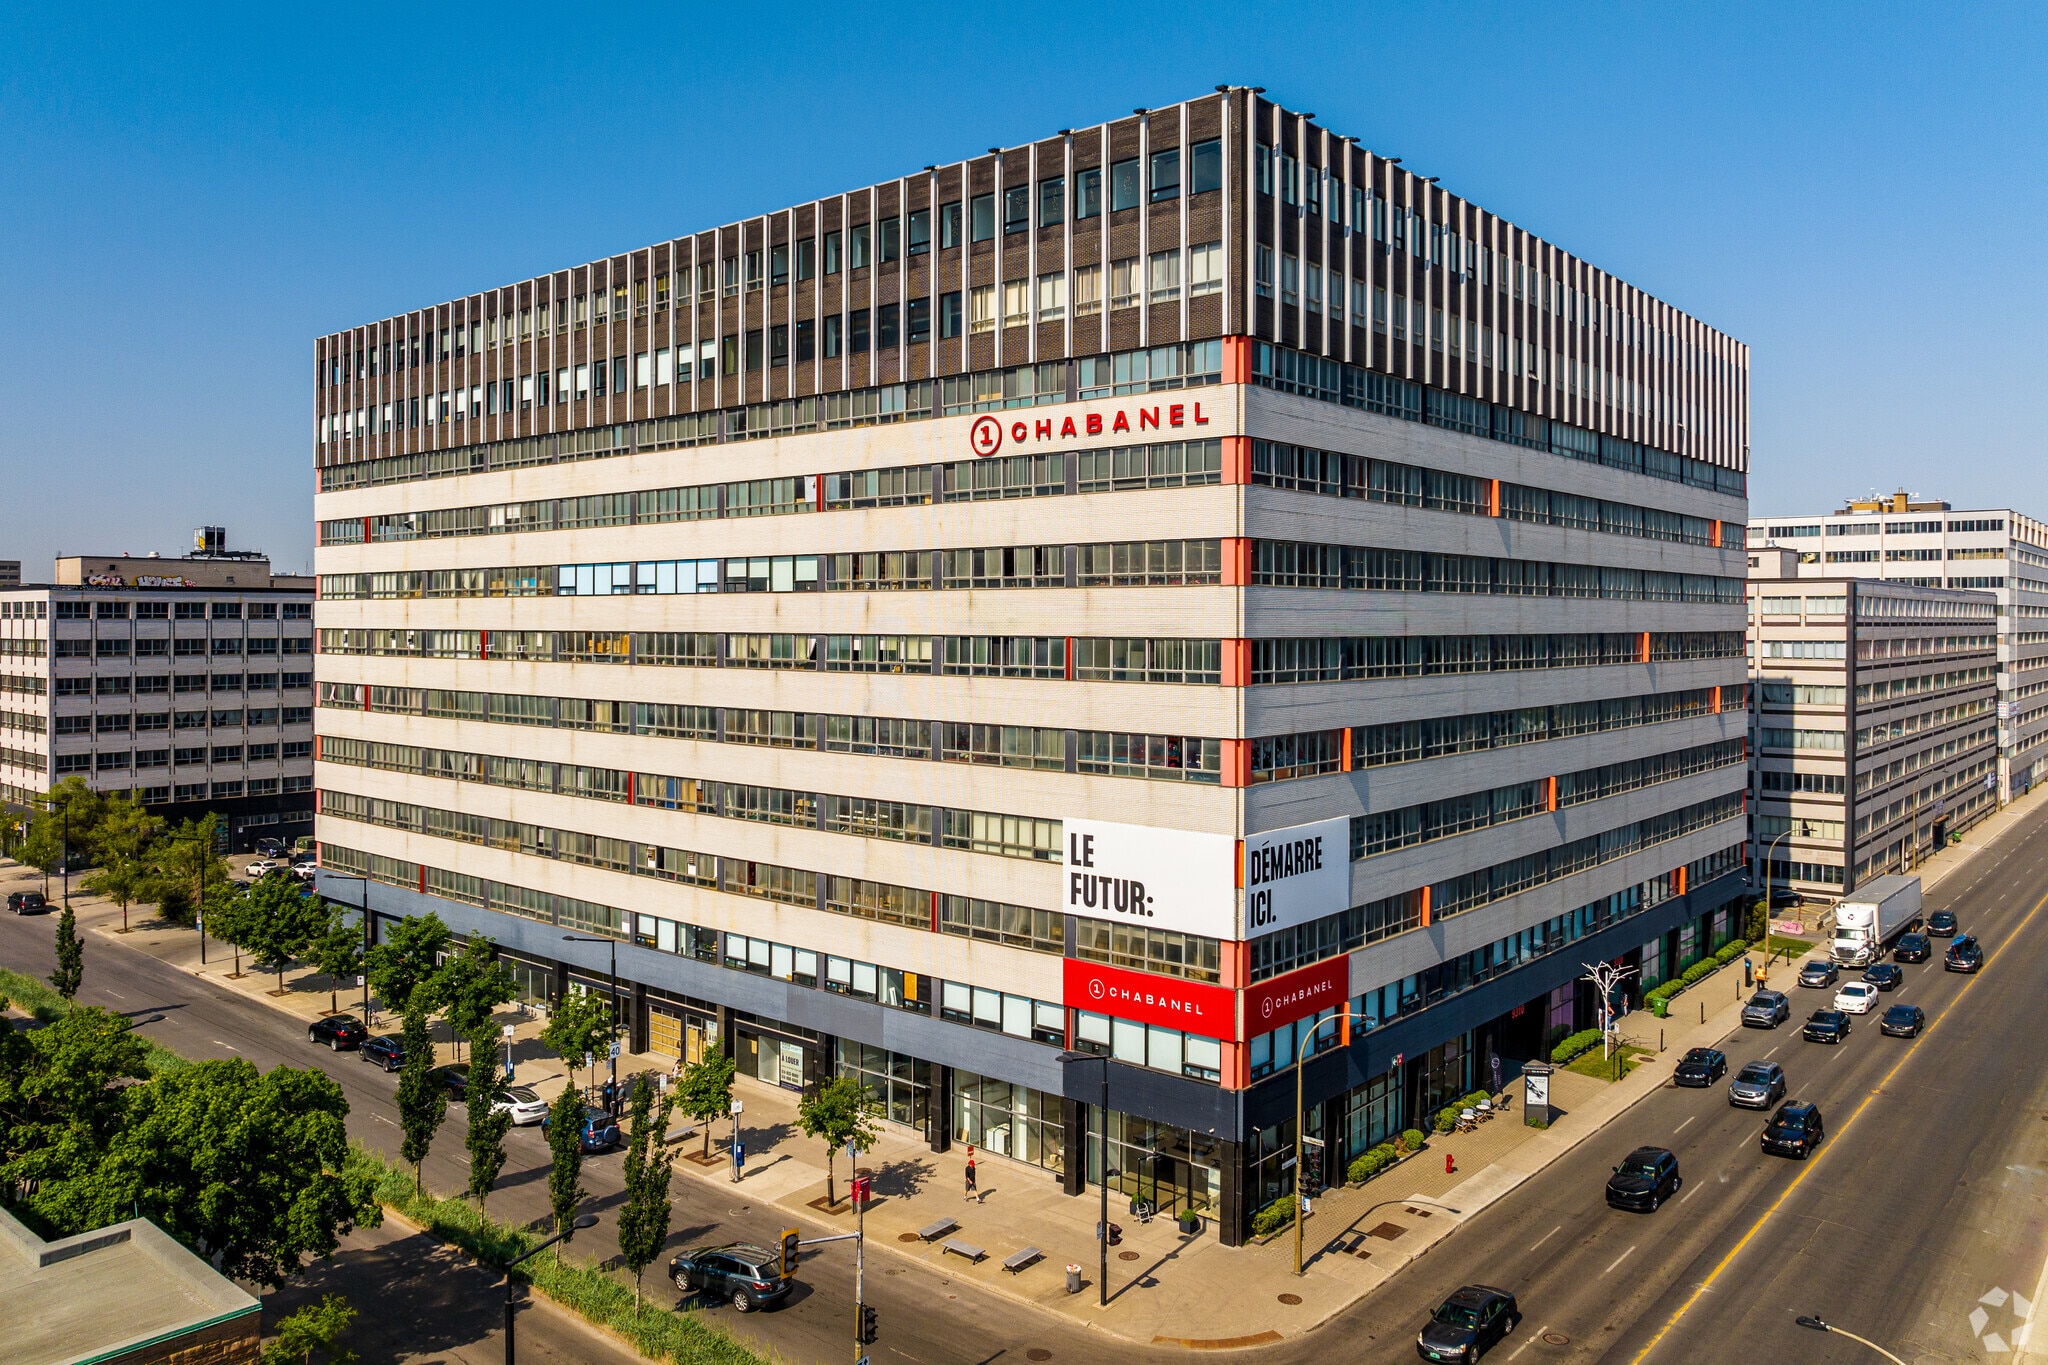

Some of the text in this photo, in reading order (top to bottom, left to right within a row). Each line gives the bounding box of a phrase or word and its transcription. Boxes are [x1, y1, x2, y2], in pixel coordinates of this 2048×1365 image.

[980, 402, 1210, 445] 1 CHABANEL
[1070, 832, 1094, 868] LE
[1251, 836, 1323, 886] DÉMARRE
[1070, 872, 1154, 917] FUTUR:
[1250, 889, 1277, 929] ICI.
[1109, 987, 1203, 1015] CHABANEL
[1275, 980, 1333, 1008] CHABANEL
[611, 1046, 620, 1056] 40
[785, 1055, 800, 1066] LOUER
